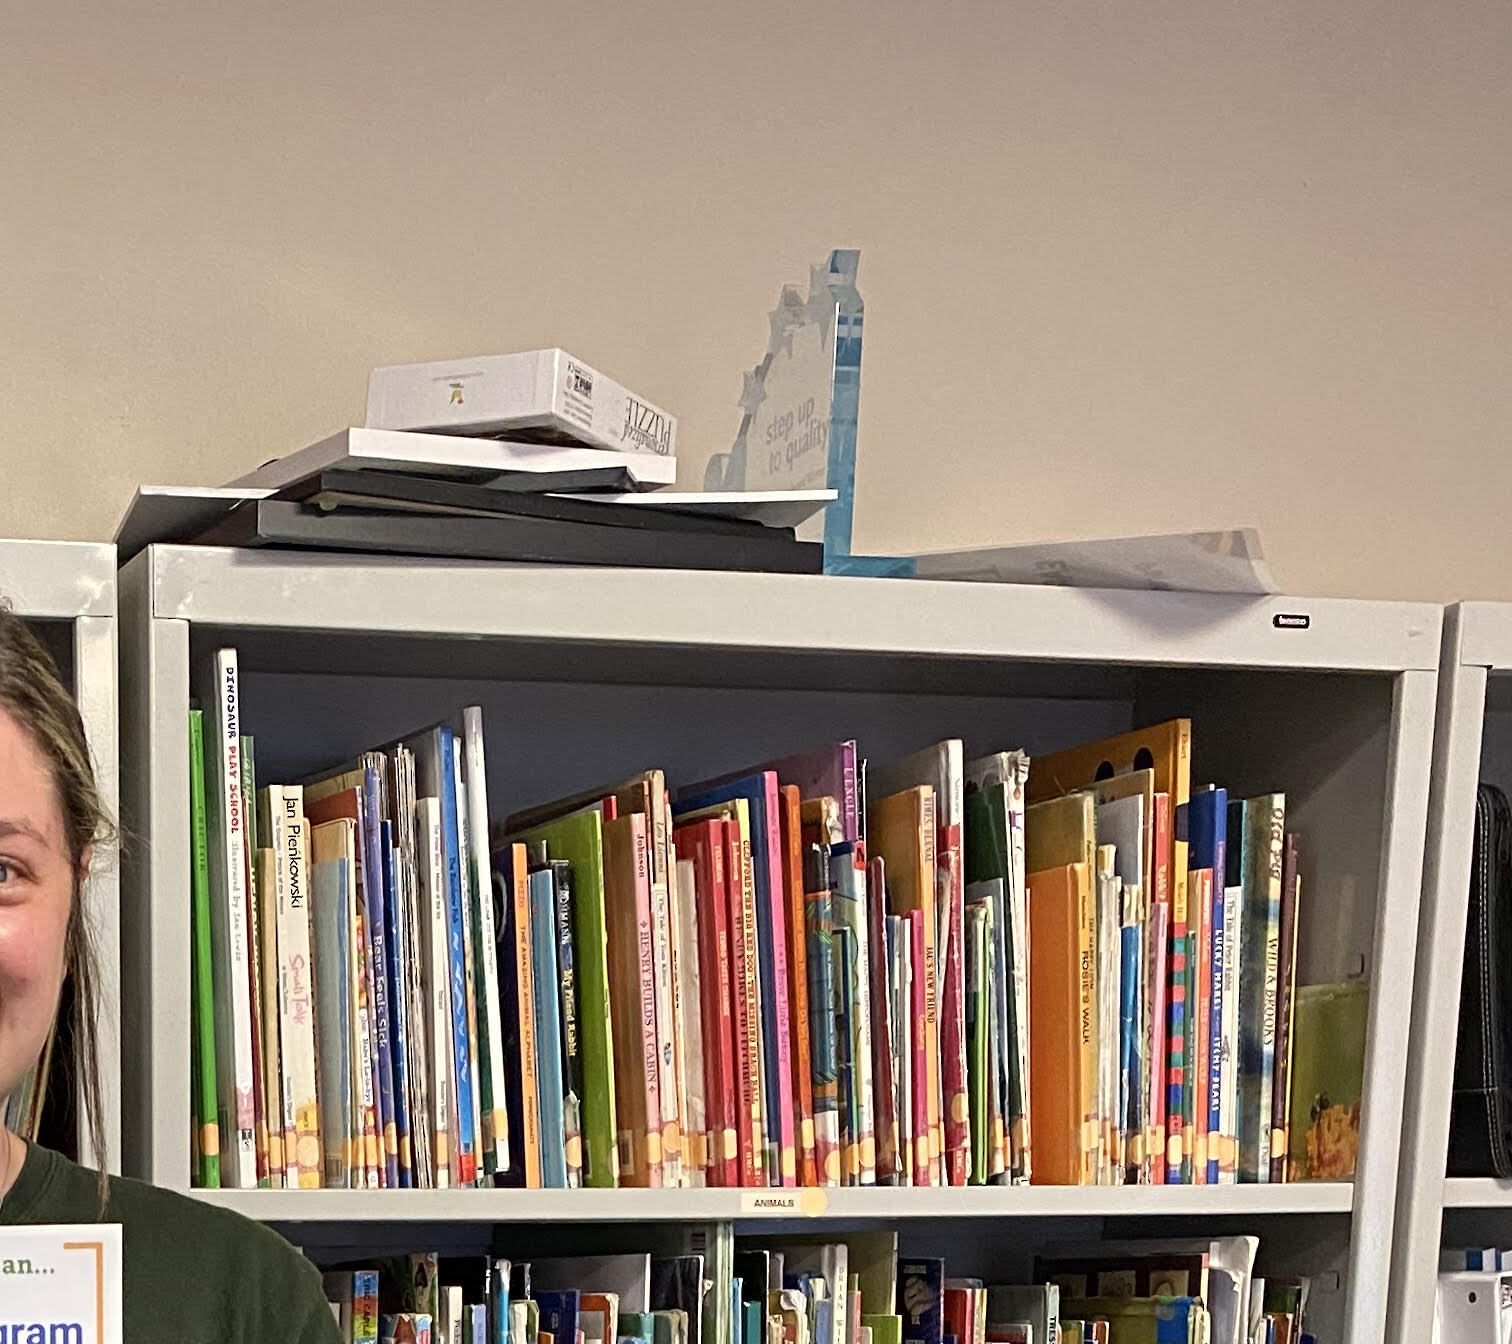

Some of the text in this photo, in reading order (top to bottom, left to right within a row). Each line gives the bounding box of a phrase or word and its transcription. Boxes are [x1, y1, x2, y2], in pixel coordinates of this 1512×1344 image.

[766, 397, 815, 446] step up
[768, 416, 829, 473] to quality
[282, 795, 299, 818] Jan
[754, 1198, 794, 1208] ANIMALS
[2, 1257, 54, 1275] an...
